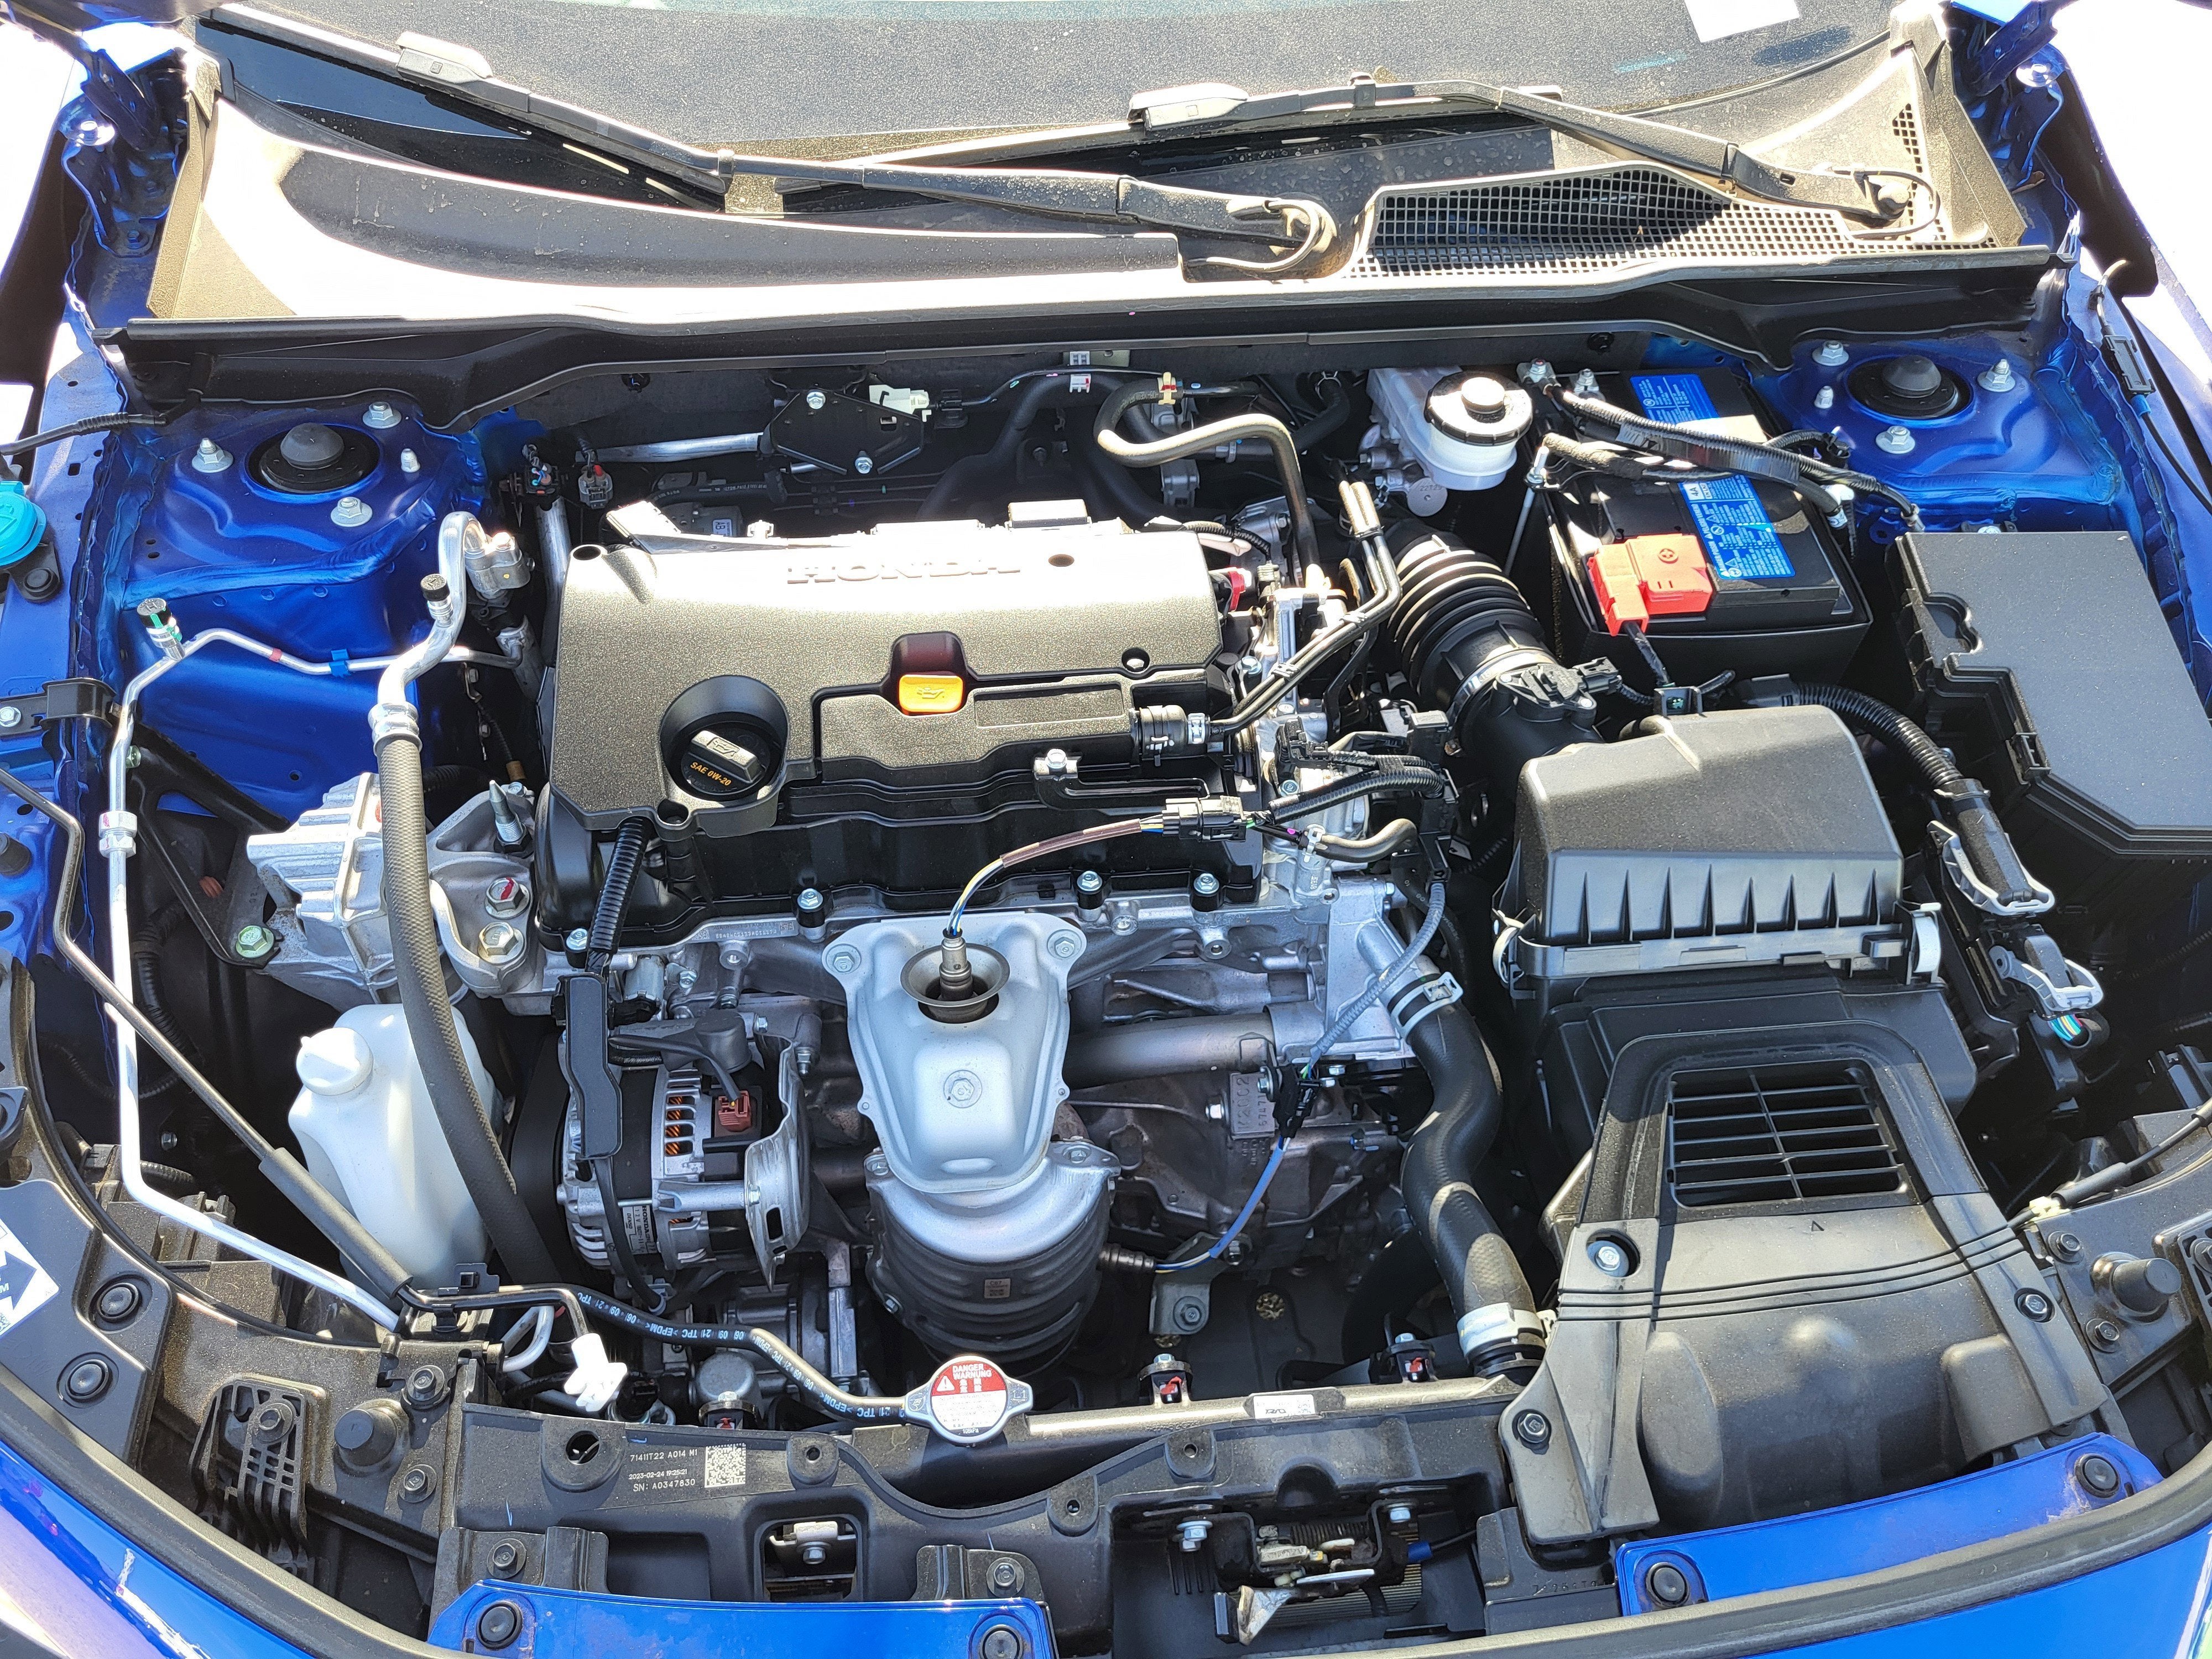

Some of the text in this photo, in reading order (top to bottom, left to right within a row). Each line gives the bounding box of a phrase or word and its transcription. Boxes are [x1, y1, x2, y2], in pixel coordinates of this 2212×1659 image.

[690, 762, 732, 786] SAE 0W-20
[681, 1329, 698, 1339] TPC
[952, 1363, 985, 1372] DANGER
[953, 1370, 992, 1380] WARNUNG
[857, 1408, 875, 1418] TPC
[630, 1452, 664, 1462] 71411T22
[667, 1449, 686, 1458] A014
[629, 1468, 687, 1480] 2023-02-24 19:25:21
[633, 1478, 696, 1492] SN: A0347830
